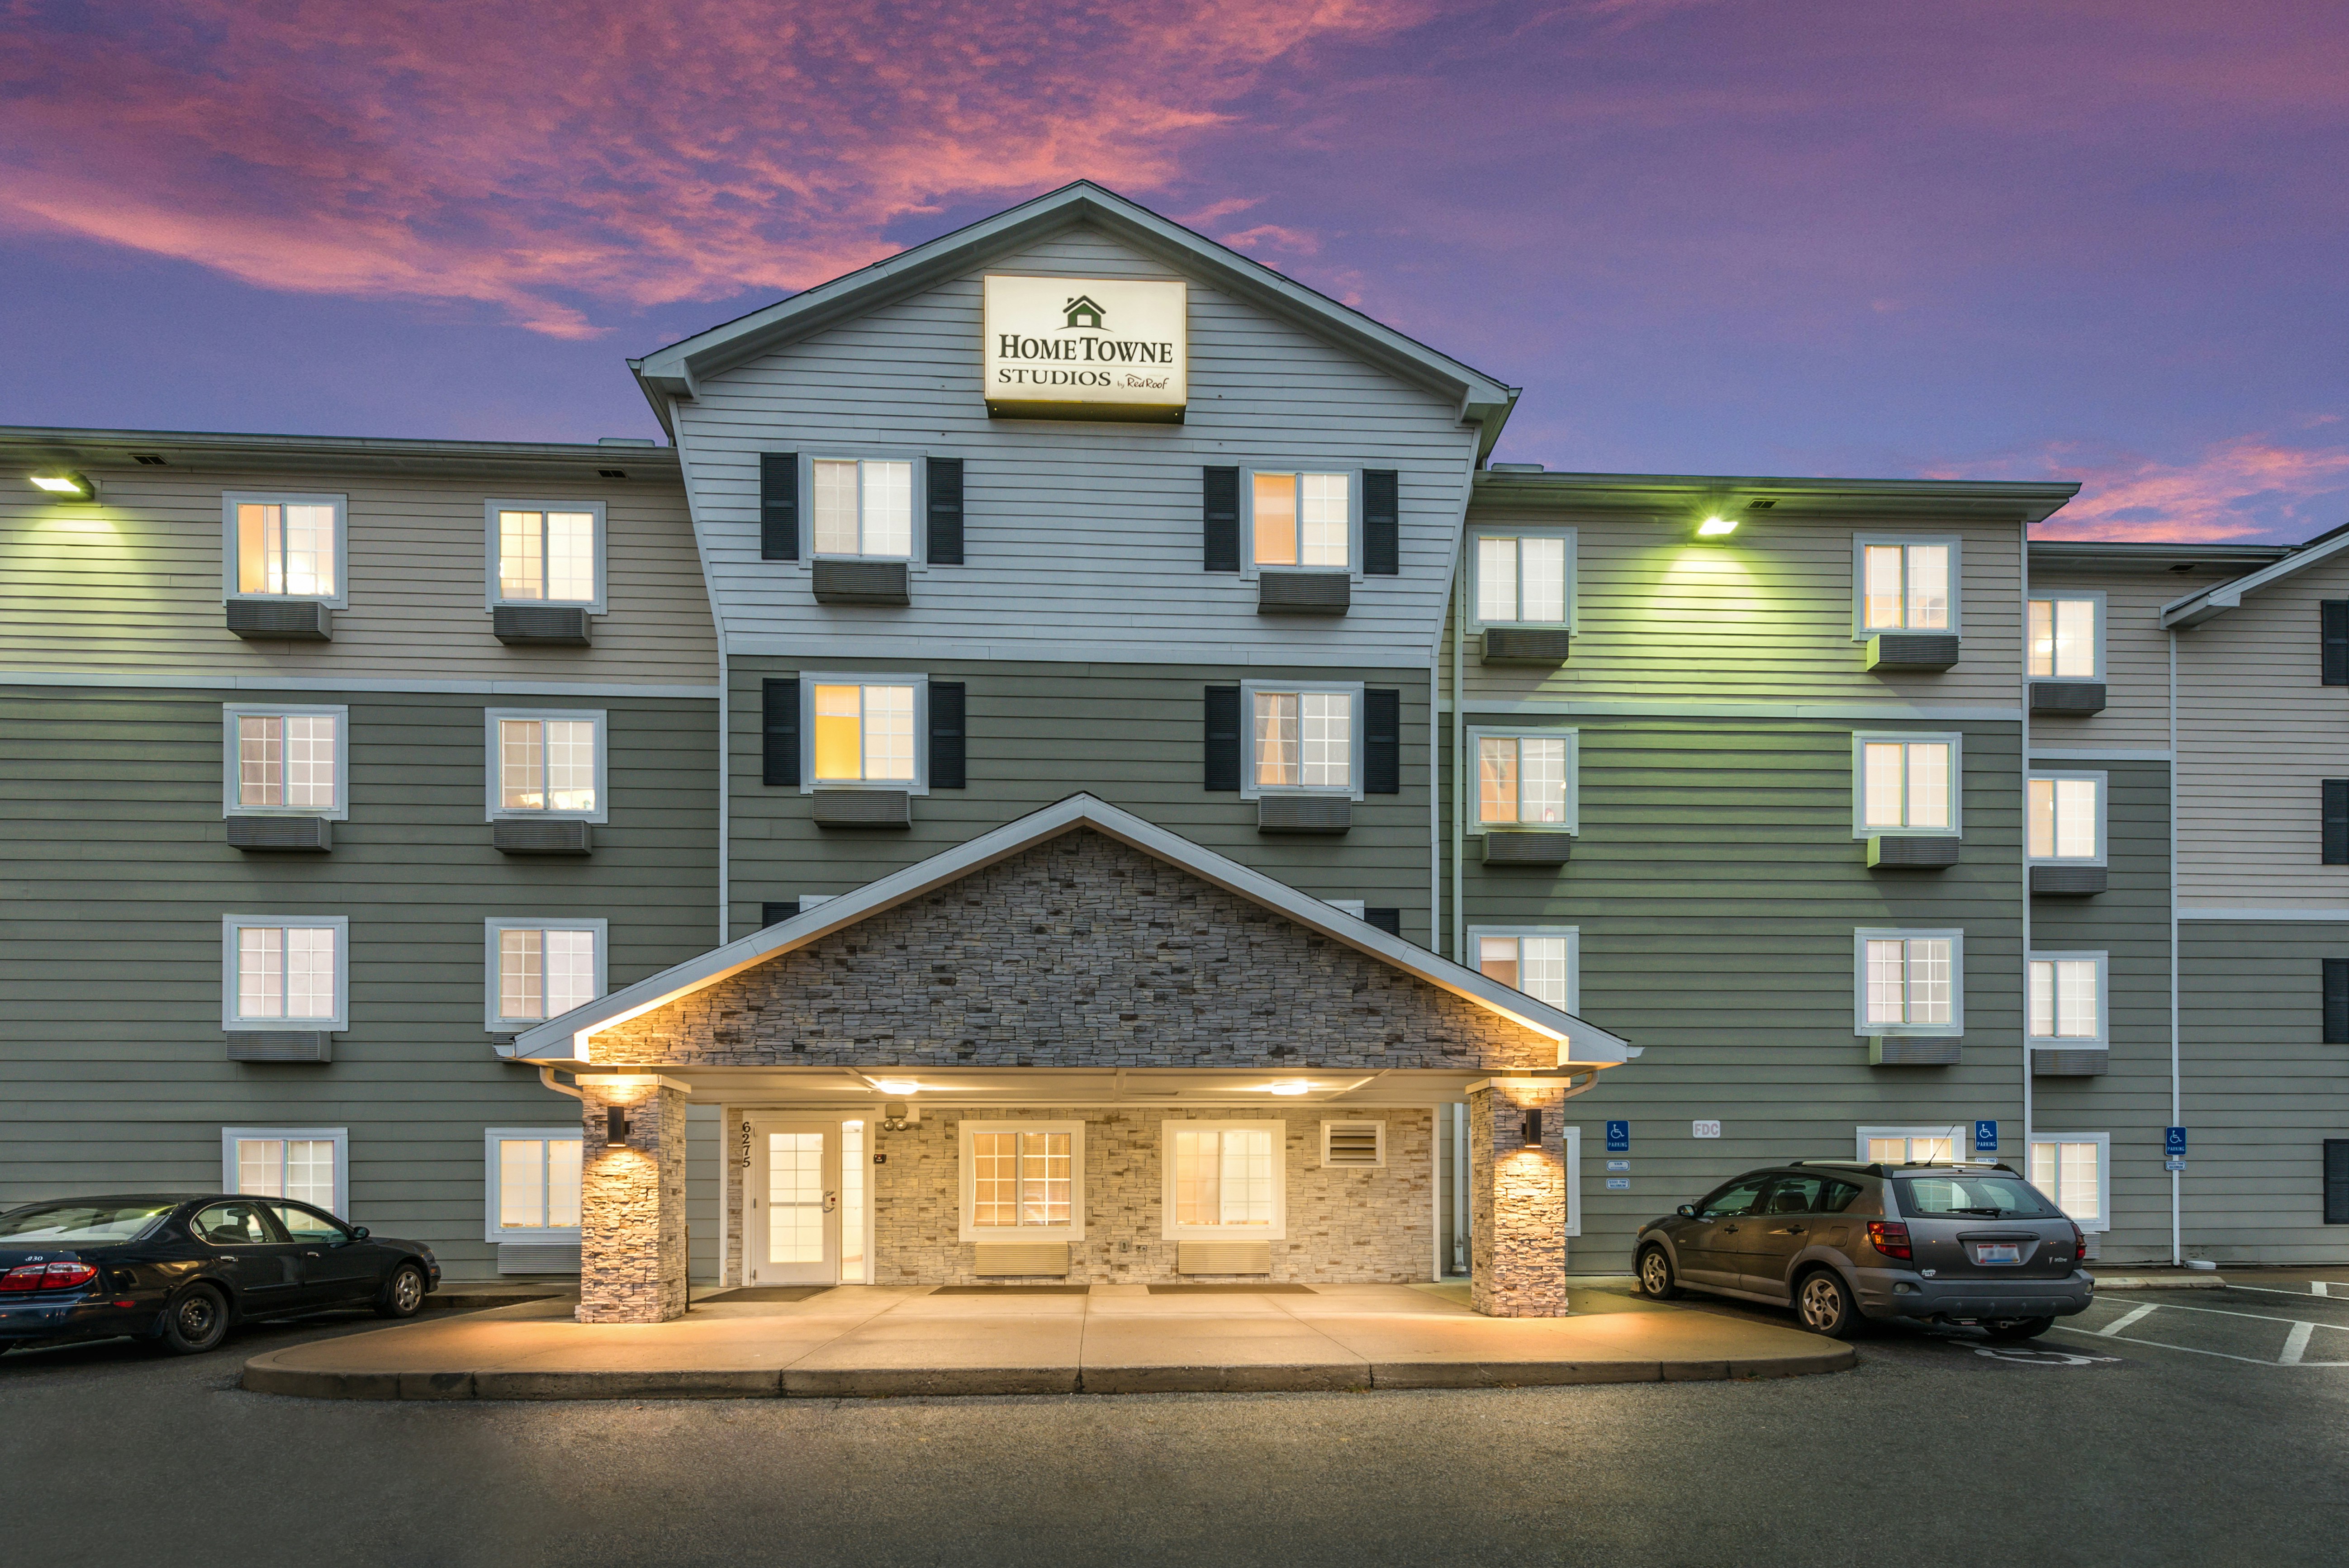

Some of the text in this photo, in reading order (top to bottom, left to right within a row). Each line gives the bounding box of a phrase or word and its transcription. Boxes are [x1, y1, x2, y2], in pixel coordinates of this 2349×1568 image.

[998, 369, 1111, 386] STUDIOS
[1117, 380, 1125, 389] by
[1694, 1123, 1719, 1136] FDC
[742, 1121, 751, 1168] 6275
